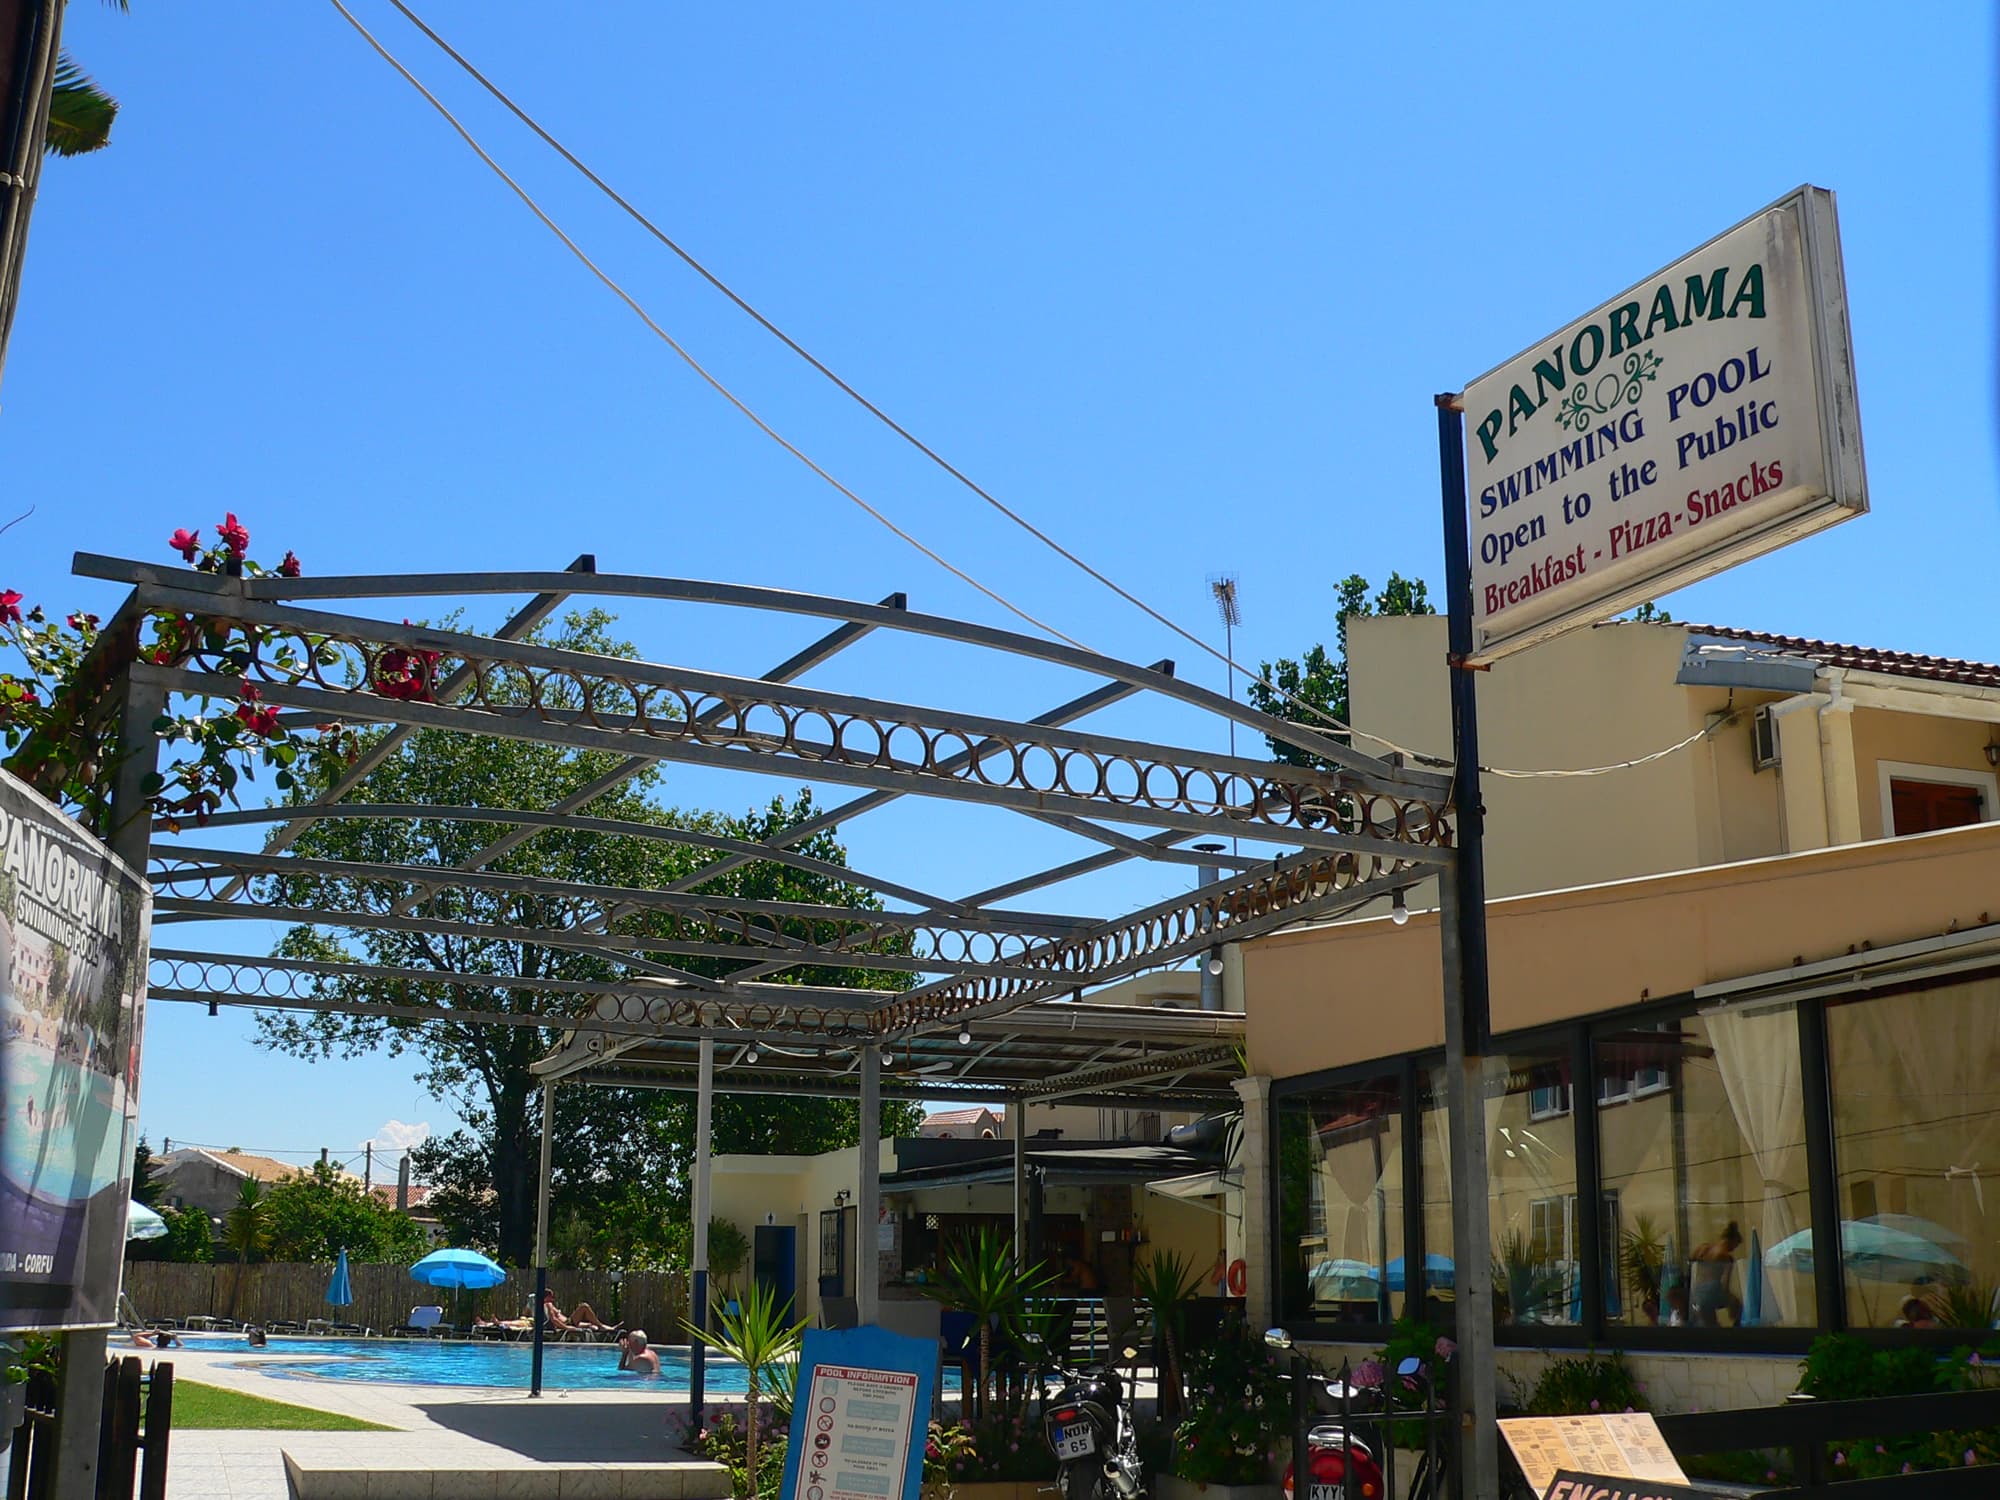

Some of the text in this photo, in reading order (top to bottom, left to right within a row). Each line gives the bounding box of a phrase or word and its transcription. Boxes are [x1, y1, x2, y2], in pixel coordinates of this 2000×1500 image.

[1475, 263, 1768, 466] PANORAMA
[1479, 346, 1772, 521] SWIMMING POOL
[1480, 400, 1780, 567] Open to the Public
[1483, 542, 1587, 617] Breakfast
[17, 893, 99, 966] SWIMMING POOL
[24, 1253, 54, 1274] CORFU
[820, 1367, 911, 1385] POOL INFORMATION
[1070, 1439, 1088, 1453] 65
